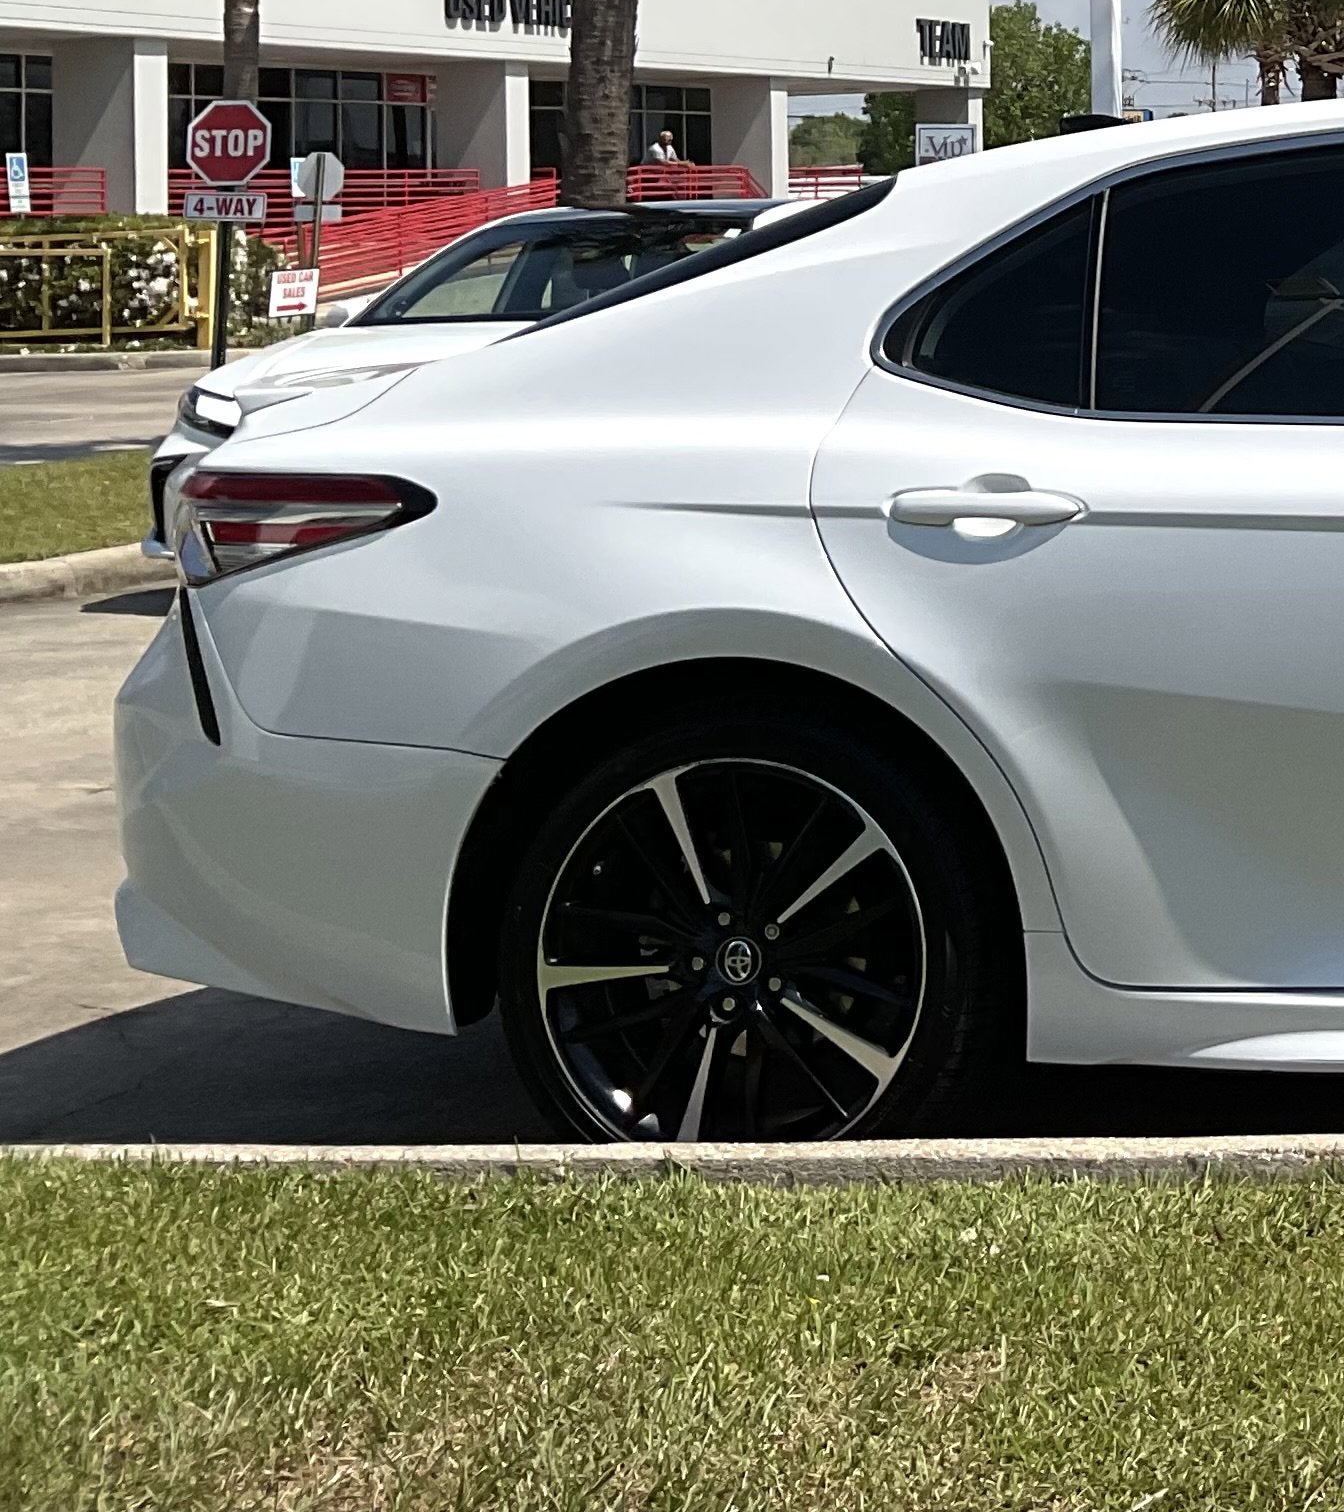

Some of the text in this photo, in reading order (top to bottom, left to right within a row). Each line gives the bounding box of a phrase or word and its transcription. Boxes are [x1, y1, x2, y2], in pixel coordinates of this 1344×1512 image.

[916, 18, 970, 60] TEAM
[194, 129, 264, 157] STOP
[193, 197, 257, 216] 4-WAY
[277, 271, 314, 284] USED CAR
[283, 287, 306, 299] SALES
